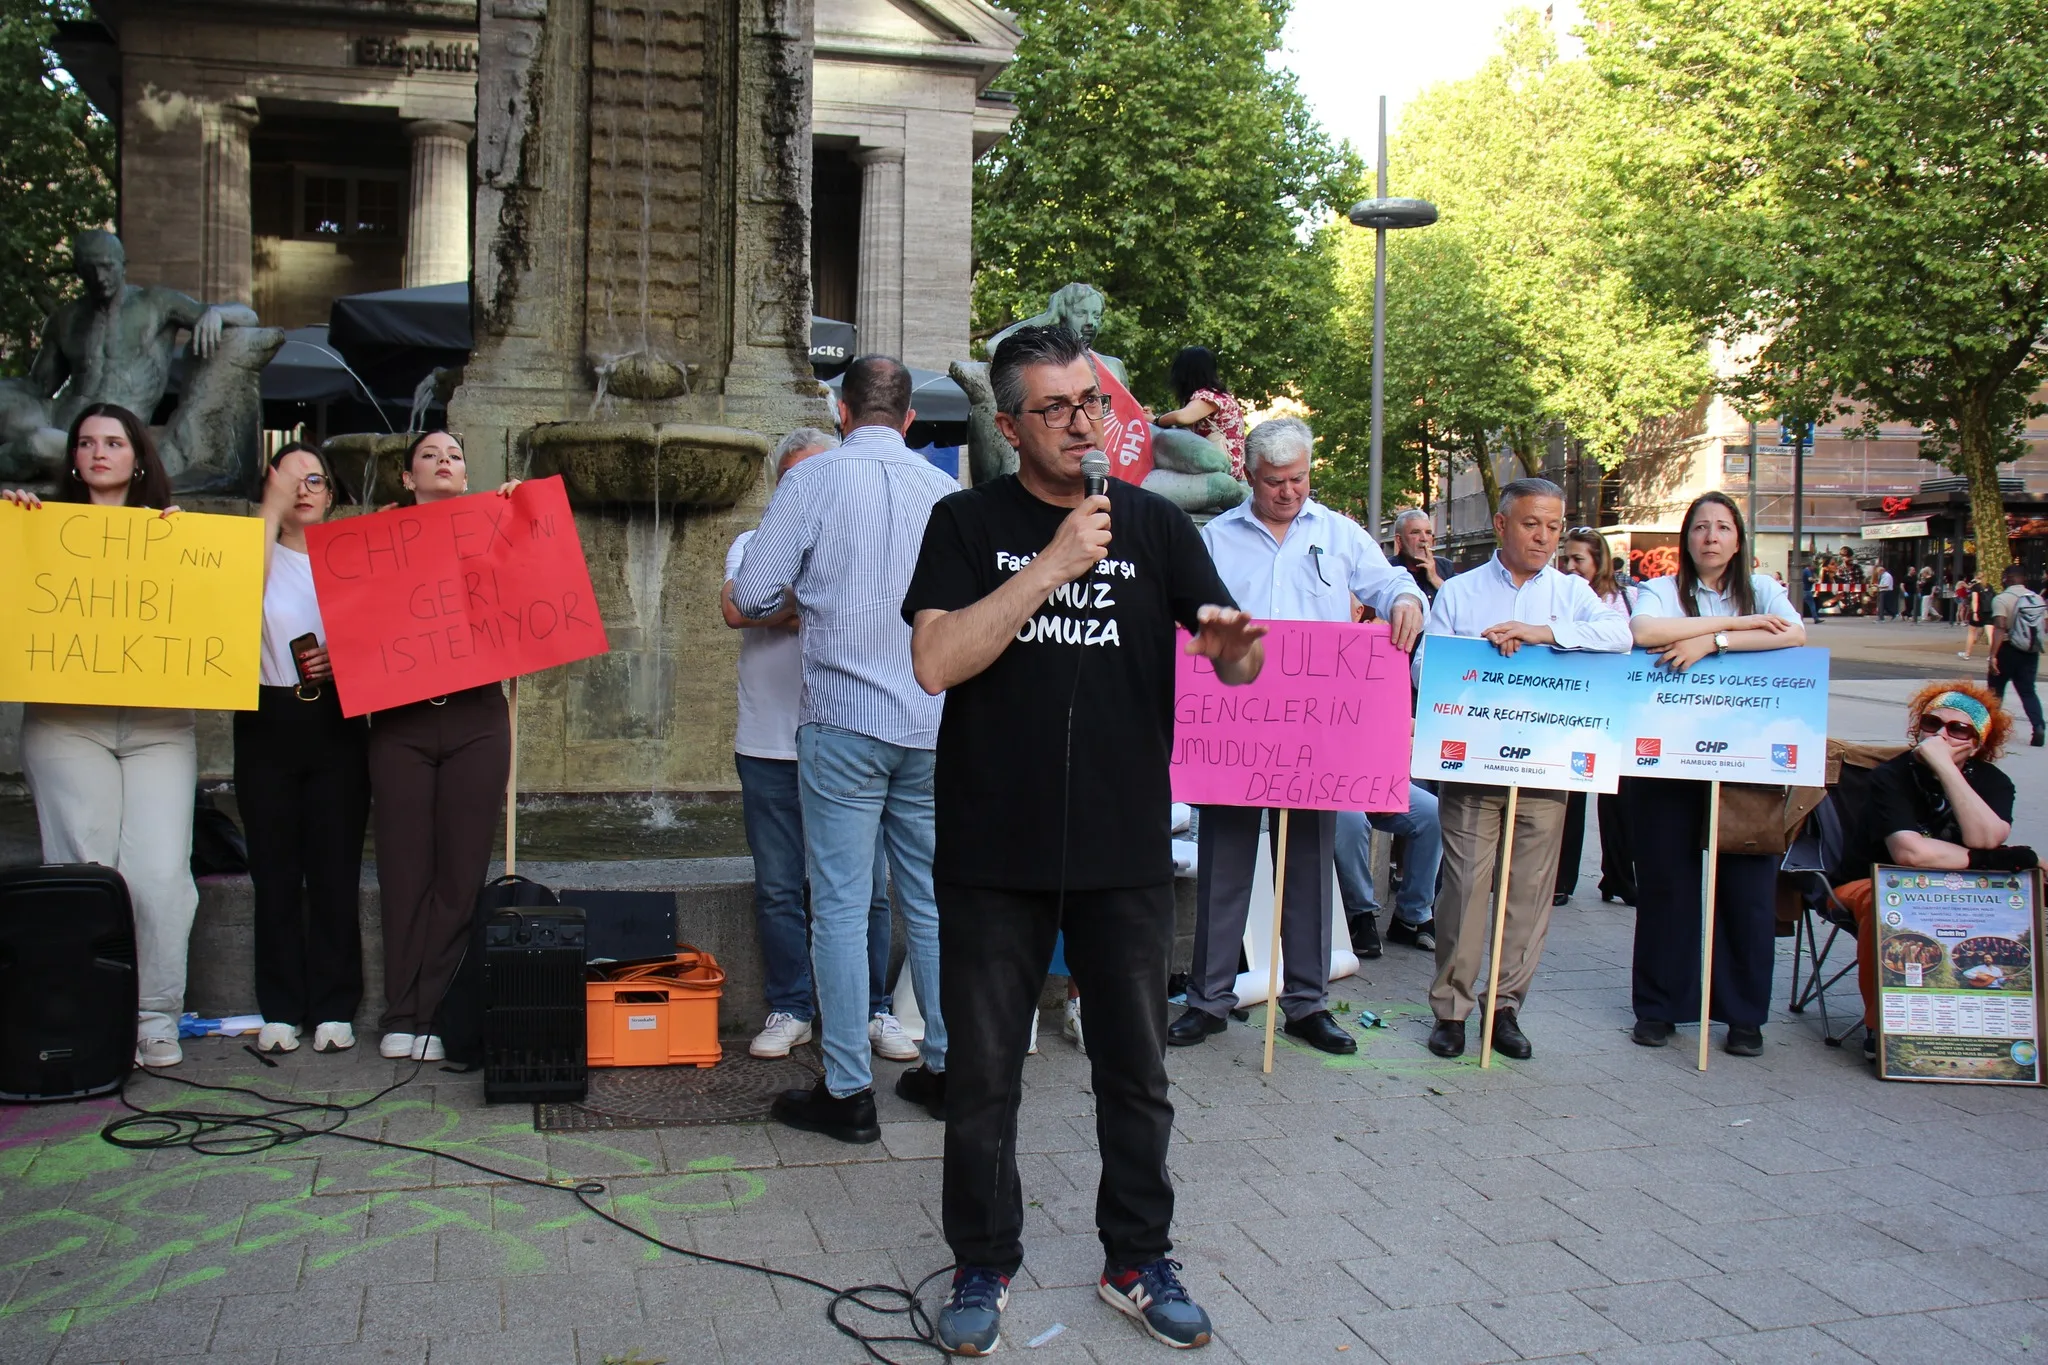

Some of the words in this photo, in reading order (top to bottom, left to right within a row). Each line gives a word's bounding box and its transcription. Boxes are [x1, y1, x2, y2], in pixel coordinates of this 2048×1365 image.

[808, 345, 845, 358] UCKS
[1119, 419, 1145, 466] CHP
[325, 519, 422, 580] CHP
[450, 507, 513, 560] EX
[1048, 582, 1116, 609] MUZ
[25, 632, 232, 677] HALKTIR
[1281, 629, 1392, 680] ÜLKE
[1462, 669, 1478, 682] JA
[1482, 671, 1504, 686] ZUR
[1508, 673, 1582, 691] DEMOKRATIE
[1646, 671, 1689, 684] MACHT
[1691, 673, 1715, 685] DES
[1719, 675, 1768, 688] VOLKES
[1771, 677, 1816, 690] GEGEN
[1656, 692, 1771, 709] RECHTSWIDRIGKEIT
[1433, 702, 1464, 715] NEIN
[1467, 706, 1490, 720] ZUR
[1493, 708, 1603, 730] RECHTSWIDRIGKEIT
[1499, 745, 1531, 759] CHP
[1695, 740, 1728, 753] CHP
[1441, 760, 1463, 770] CHP
[1484, 763, 1519, 773] HAMBURG
[1637, 757, 1659, 766] CHP
[1680, 758, 1717, 767] HAMBURG
[1904, 893, 2002, 904] WALDFESTIVAL
